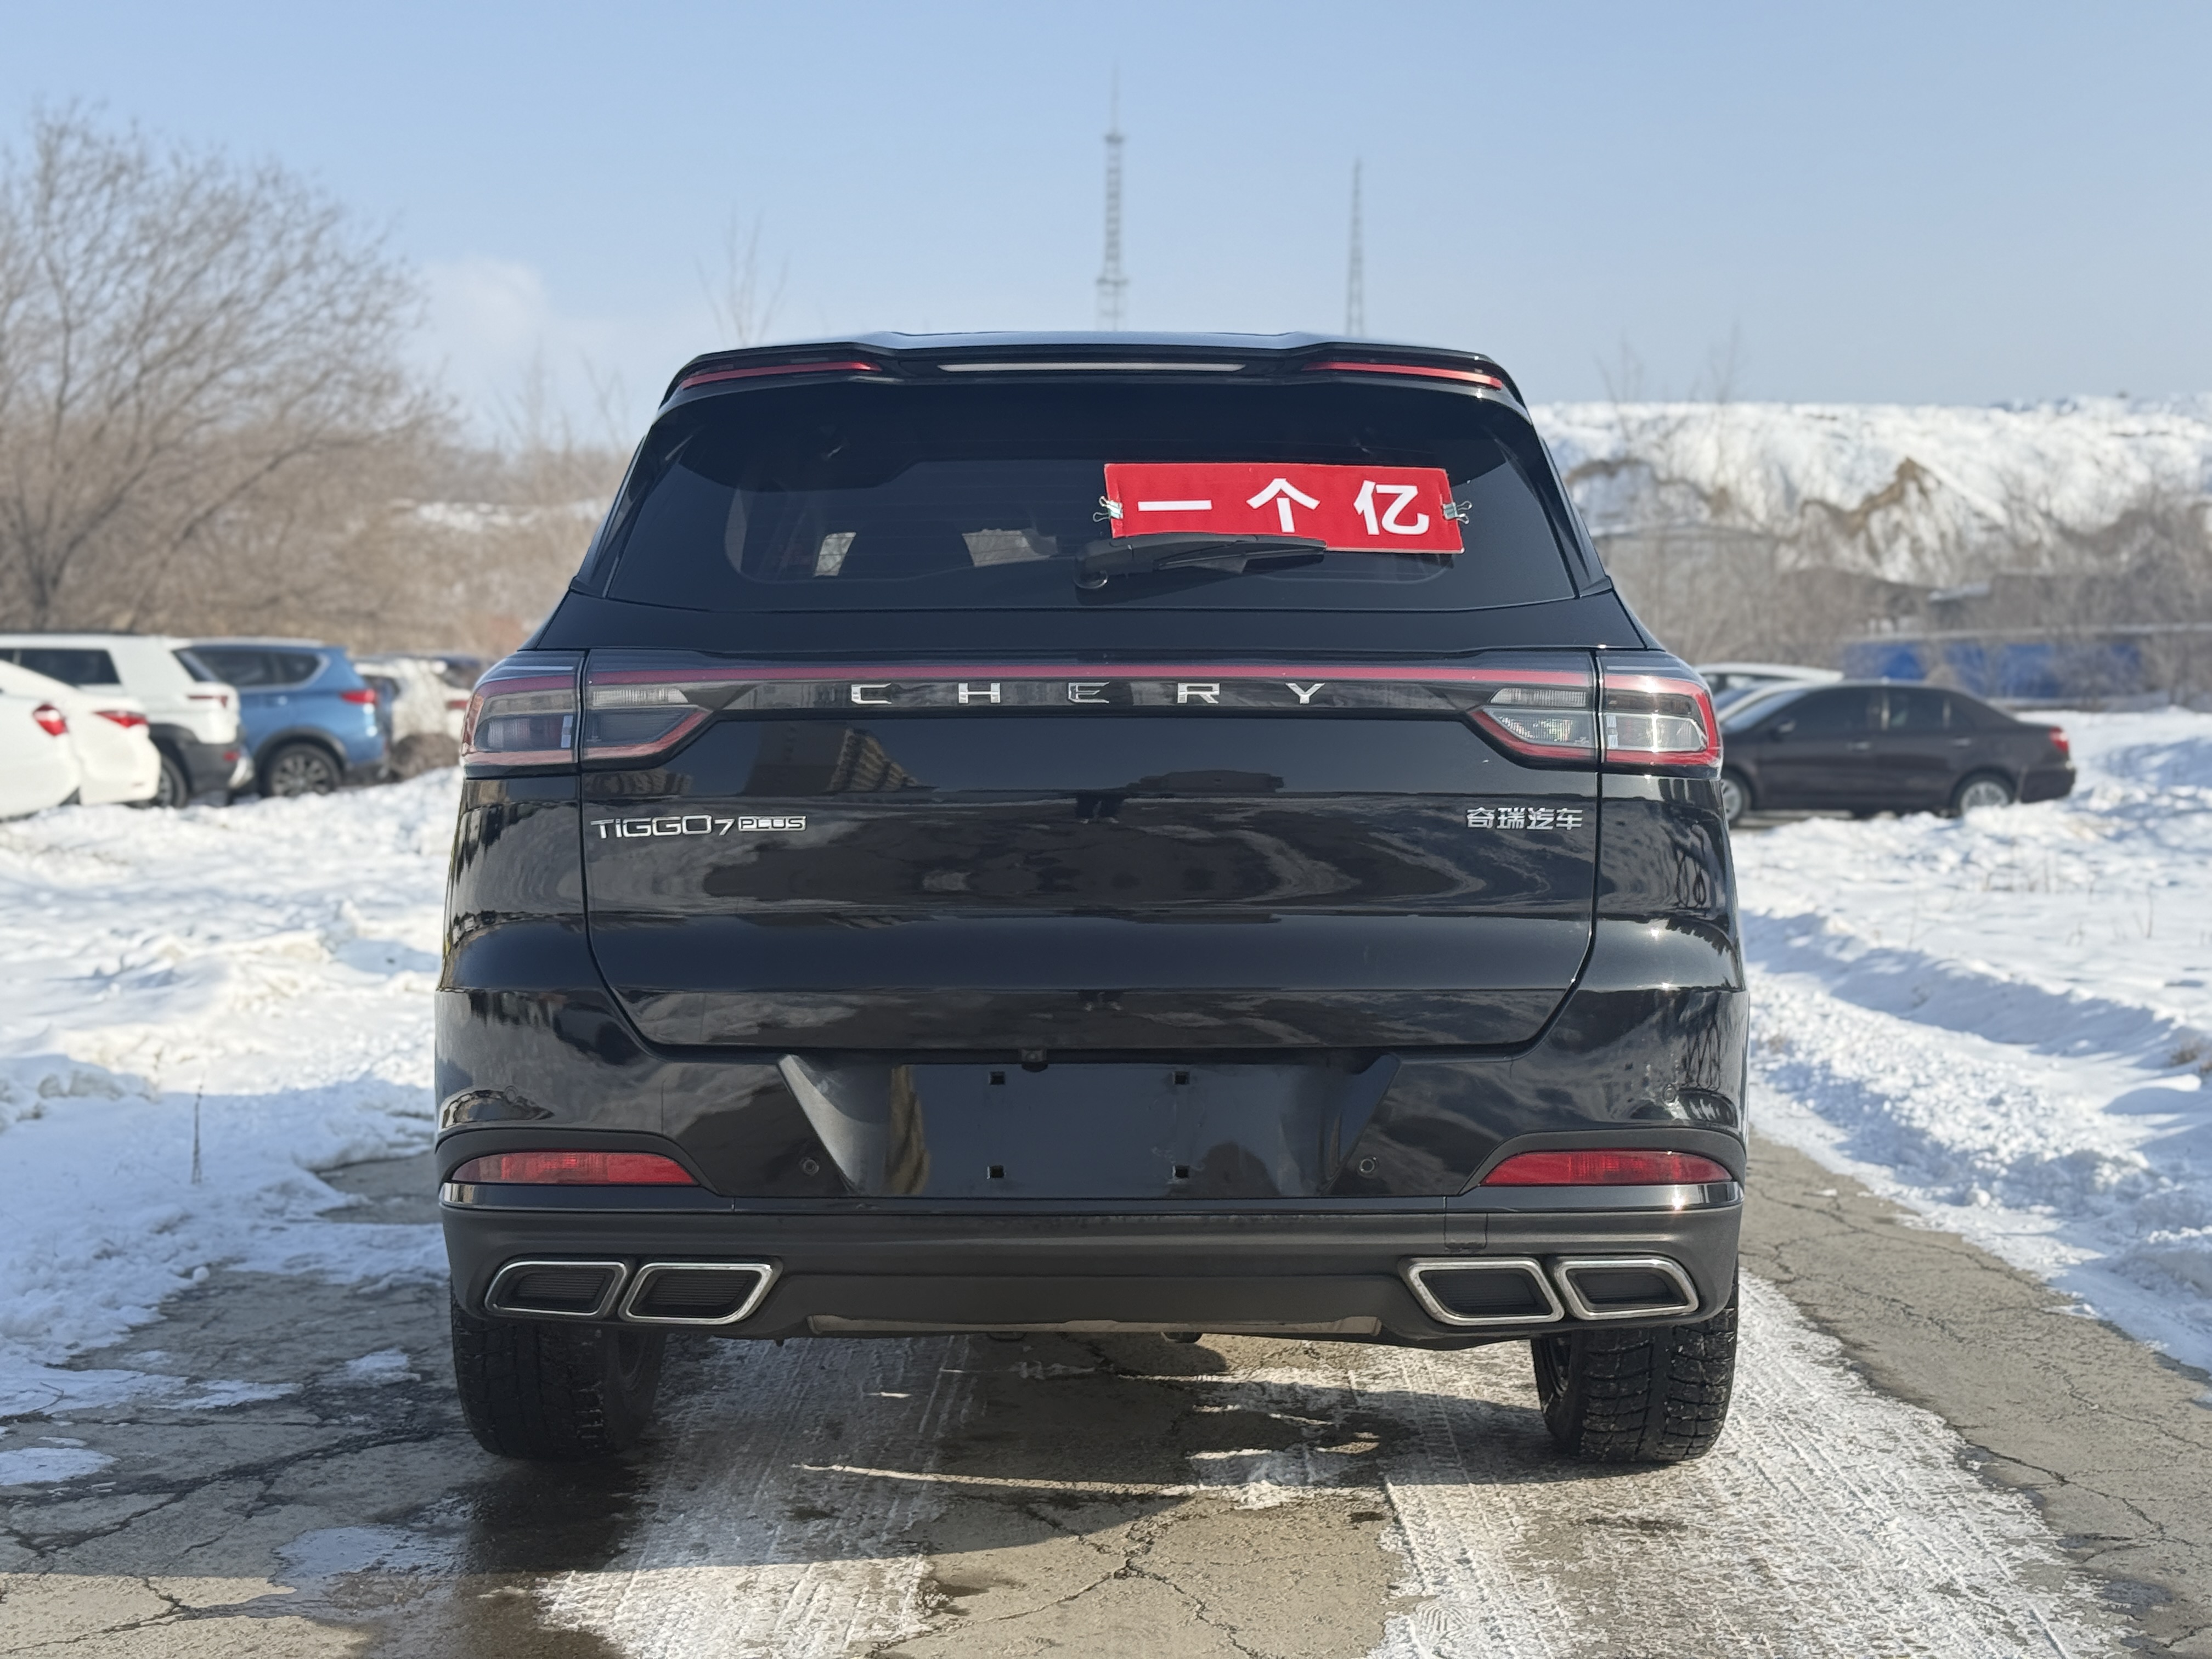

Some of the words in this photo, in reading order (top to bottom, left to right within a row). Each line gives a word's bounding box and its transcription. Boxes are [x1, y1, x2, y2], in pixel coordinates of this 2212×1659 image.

[1137, 477, 1430, 535] 一个亿
[851, 682, 1325, 705] CHERY
[740, 817, 805, 830] PLUS
[1466, 806, 1583, 831] 奇瑞汽车
